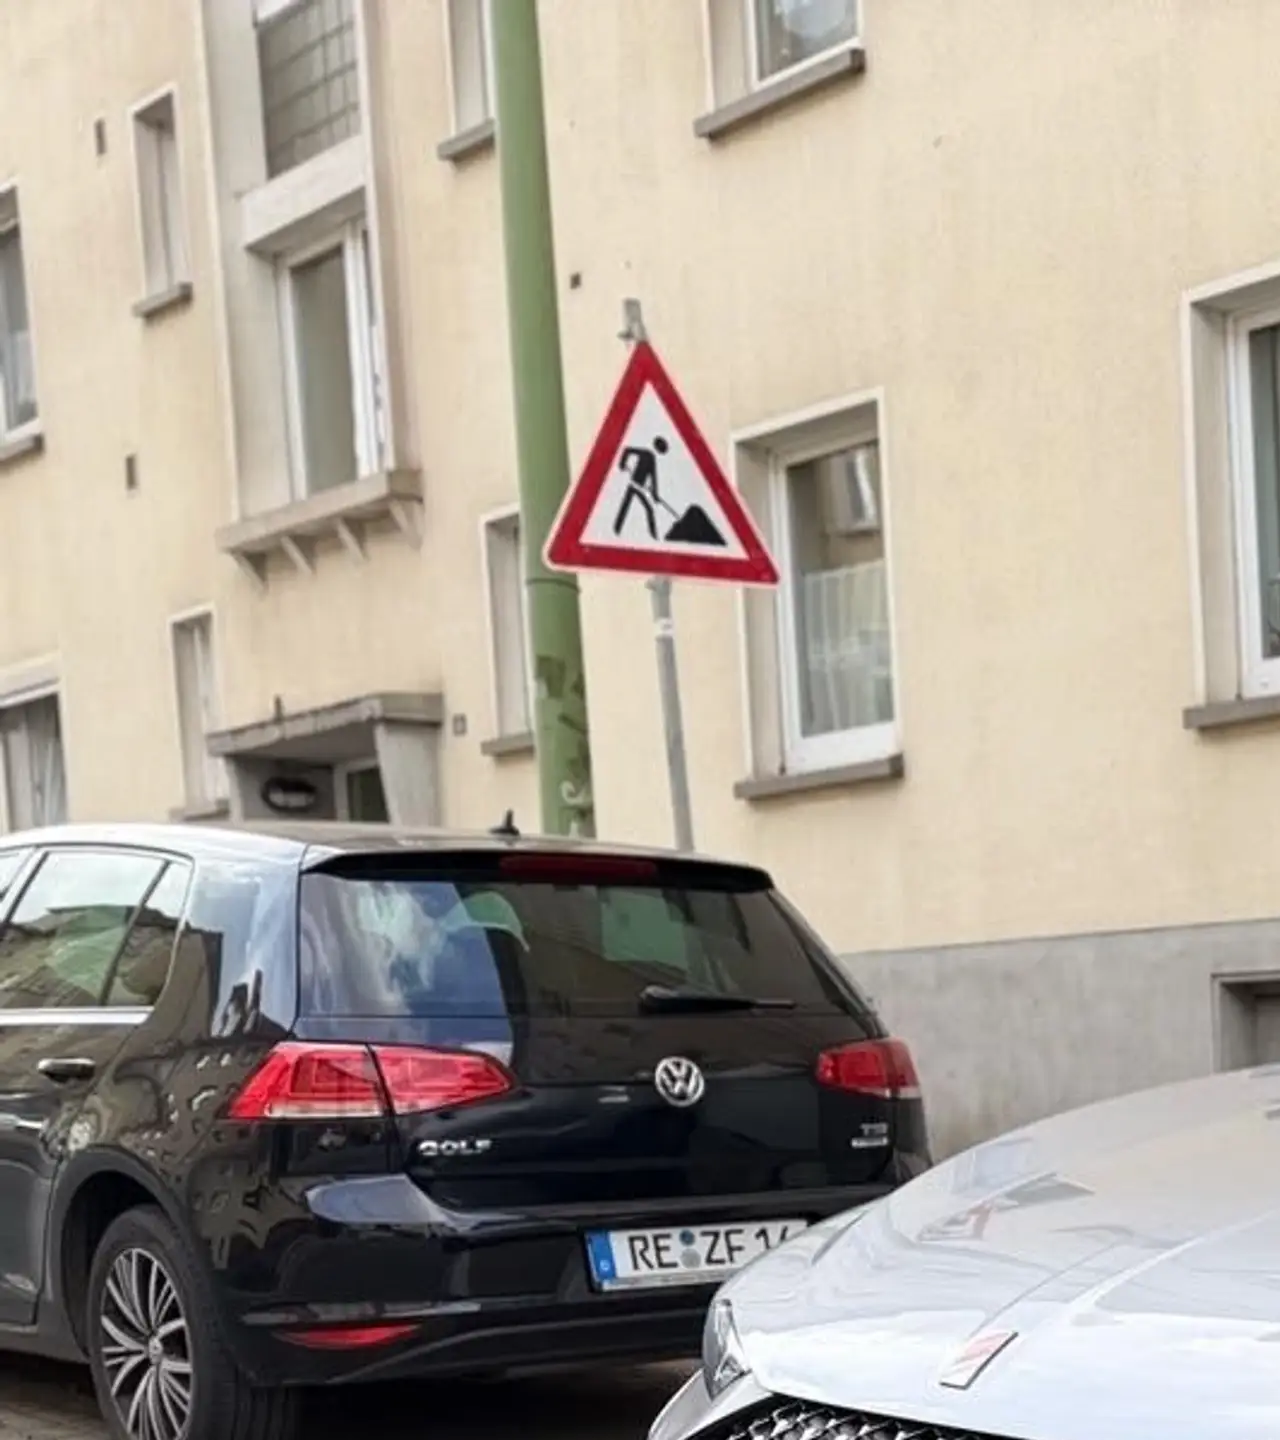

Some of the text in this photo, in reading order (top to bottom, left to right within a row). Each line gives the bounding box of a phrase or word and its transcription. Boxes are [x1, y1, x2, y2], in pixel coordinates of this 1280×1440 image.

[418, 1139, 491, 1156] GOLF
[628, 1233, 678, 1271] RE
[701, 1229, 745, 1266] ZF
